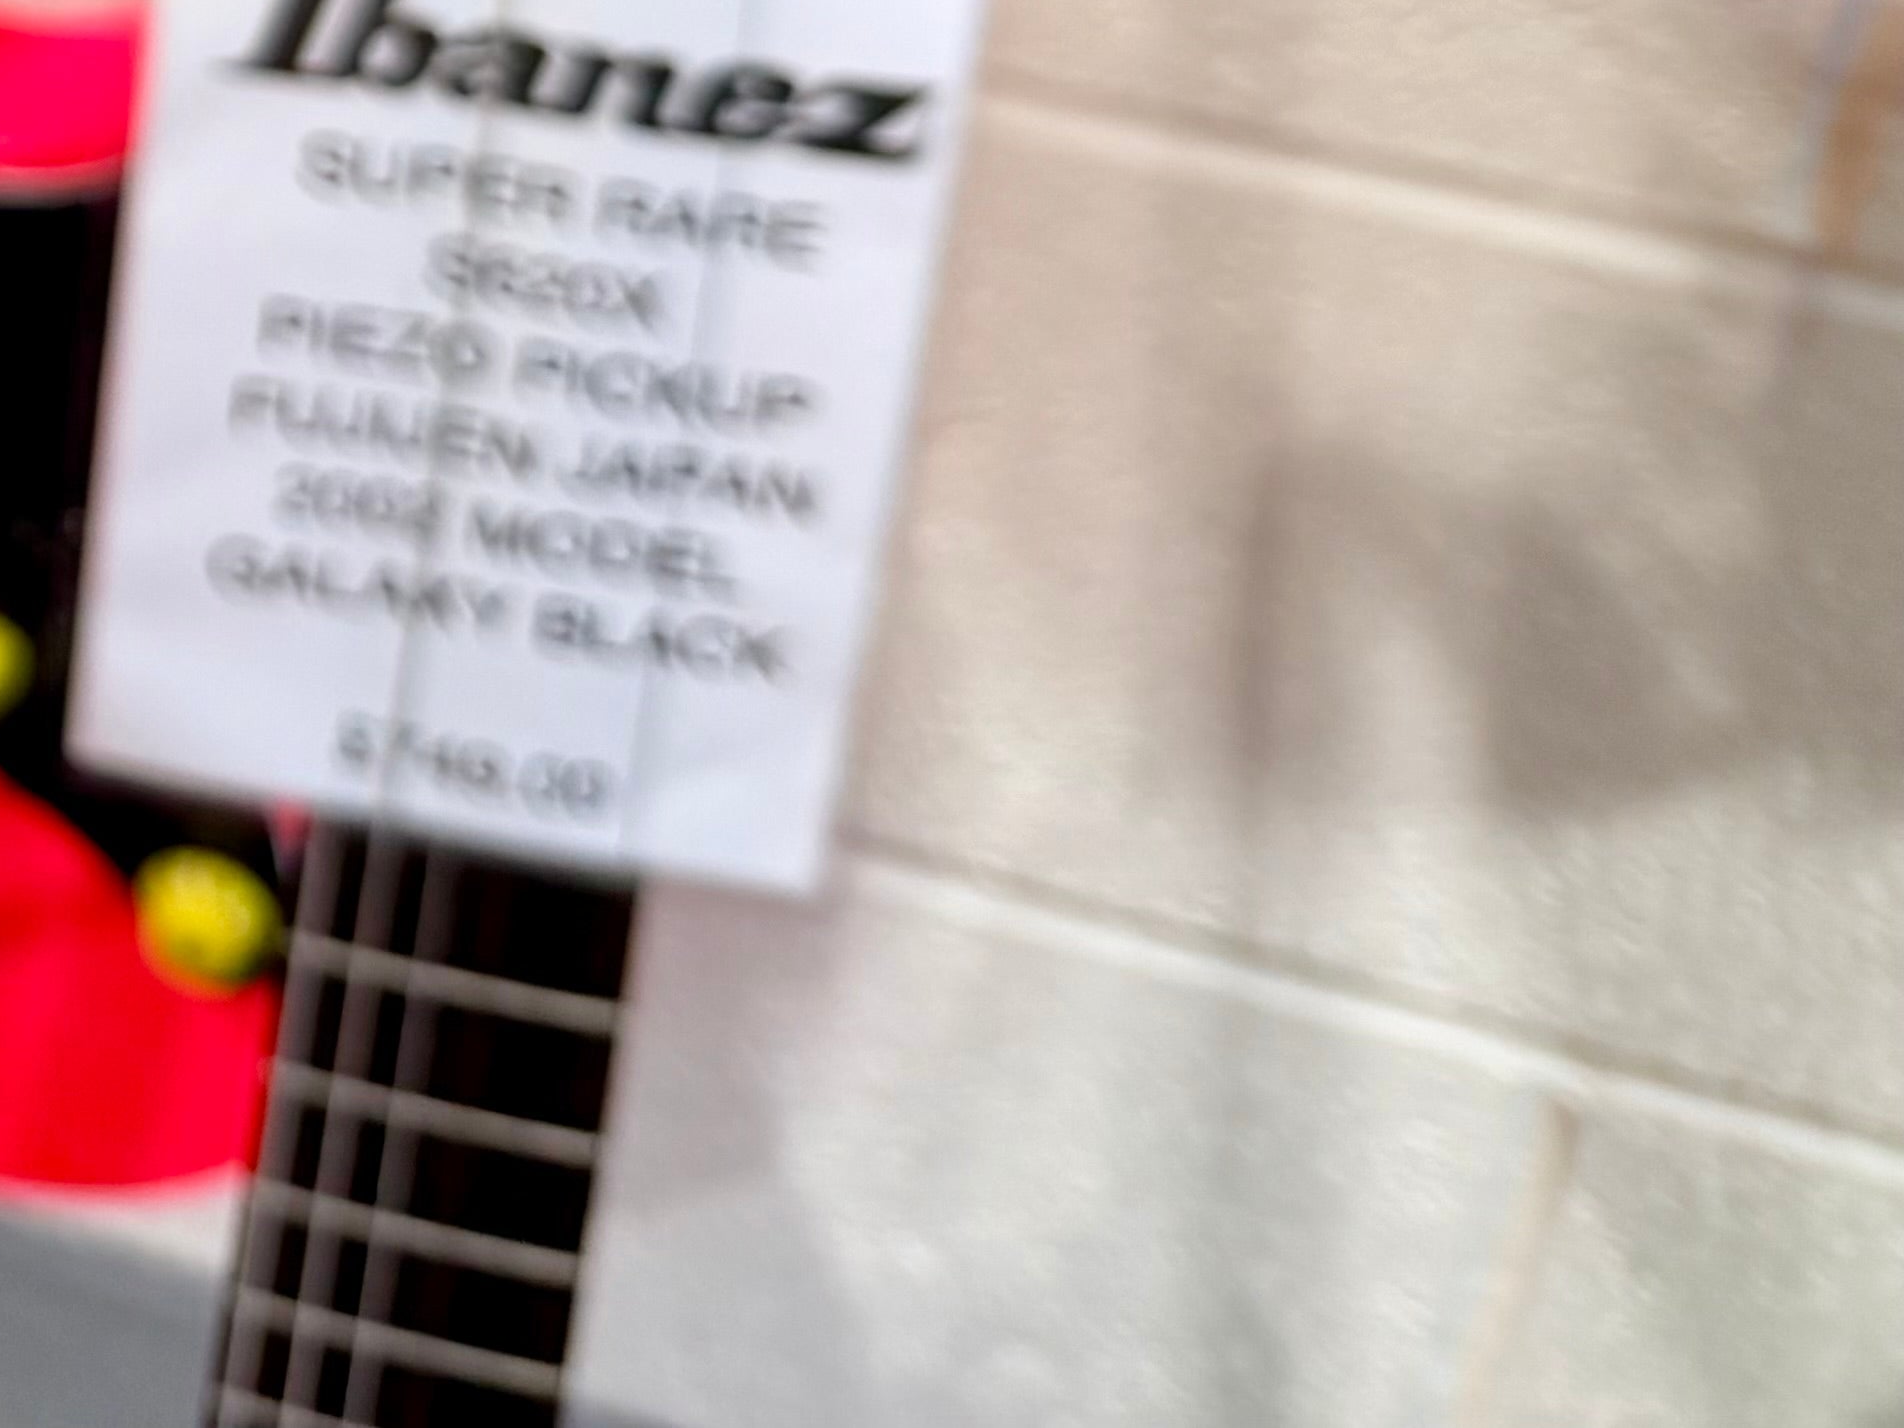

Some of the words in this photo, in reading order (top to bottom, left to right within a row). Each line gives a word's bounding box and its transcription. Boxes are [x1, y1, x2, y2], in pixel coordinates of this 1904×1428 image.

[299, 136, 573, 227] SUPER
[596, 182, 825, 265] RARE
[258, 301, 495, 382] PIEZO
[516, 346, 820, 438] PICKUP
[560, 438, 817, 522] JAPAN
[206, 541, 510, 634] GALAXY
[532, 599, 786, 683] BLACK
[466, 506, 737, 593] MODEL
